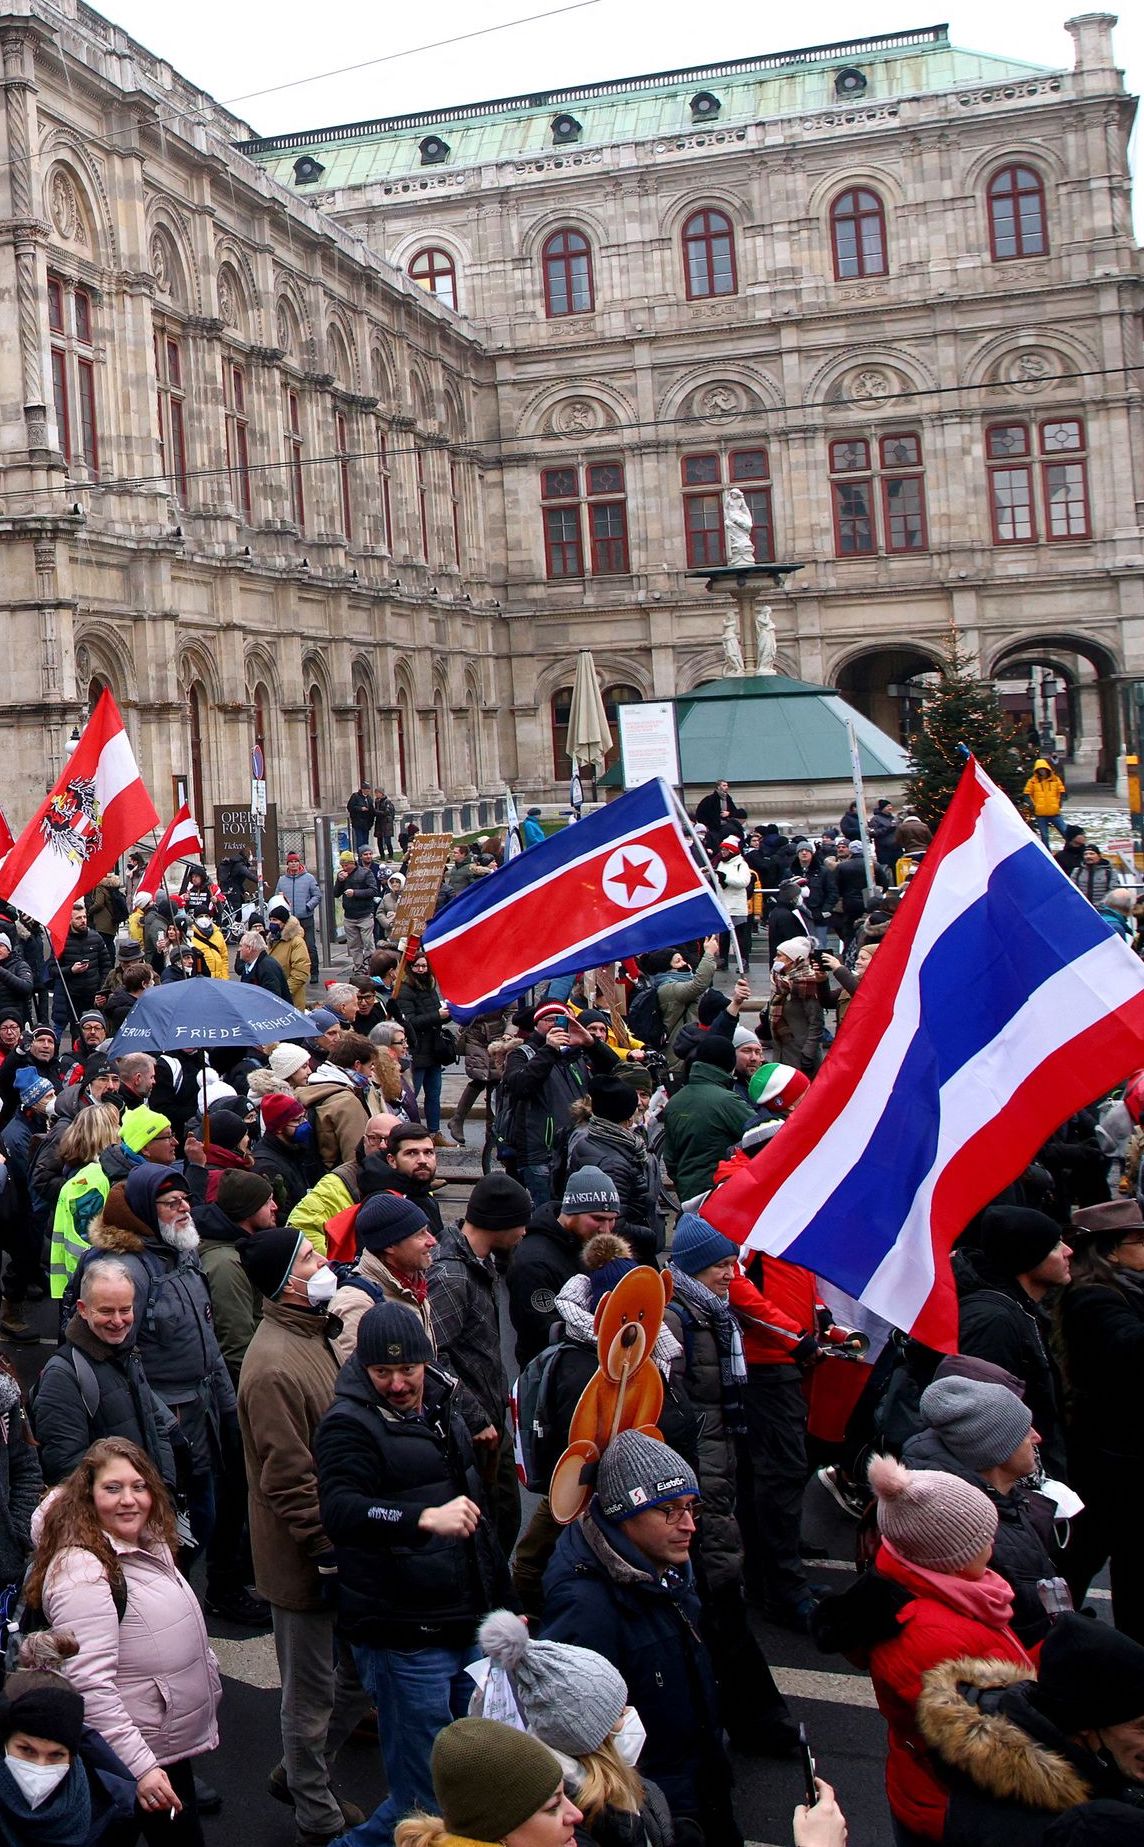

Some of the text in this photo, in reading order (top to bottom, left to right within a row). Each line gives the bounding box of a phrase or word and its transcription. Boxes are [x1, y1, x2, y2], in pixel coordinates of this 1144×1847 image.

[571, 1191, 608, 1204] ANSGAR
[657, 1477, 685, 1492] Eisbär
[604, 1503, 623, 1515] isbär
